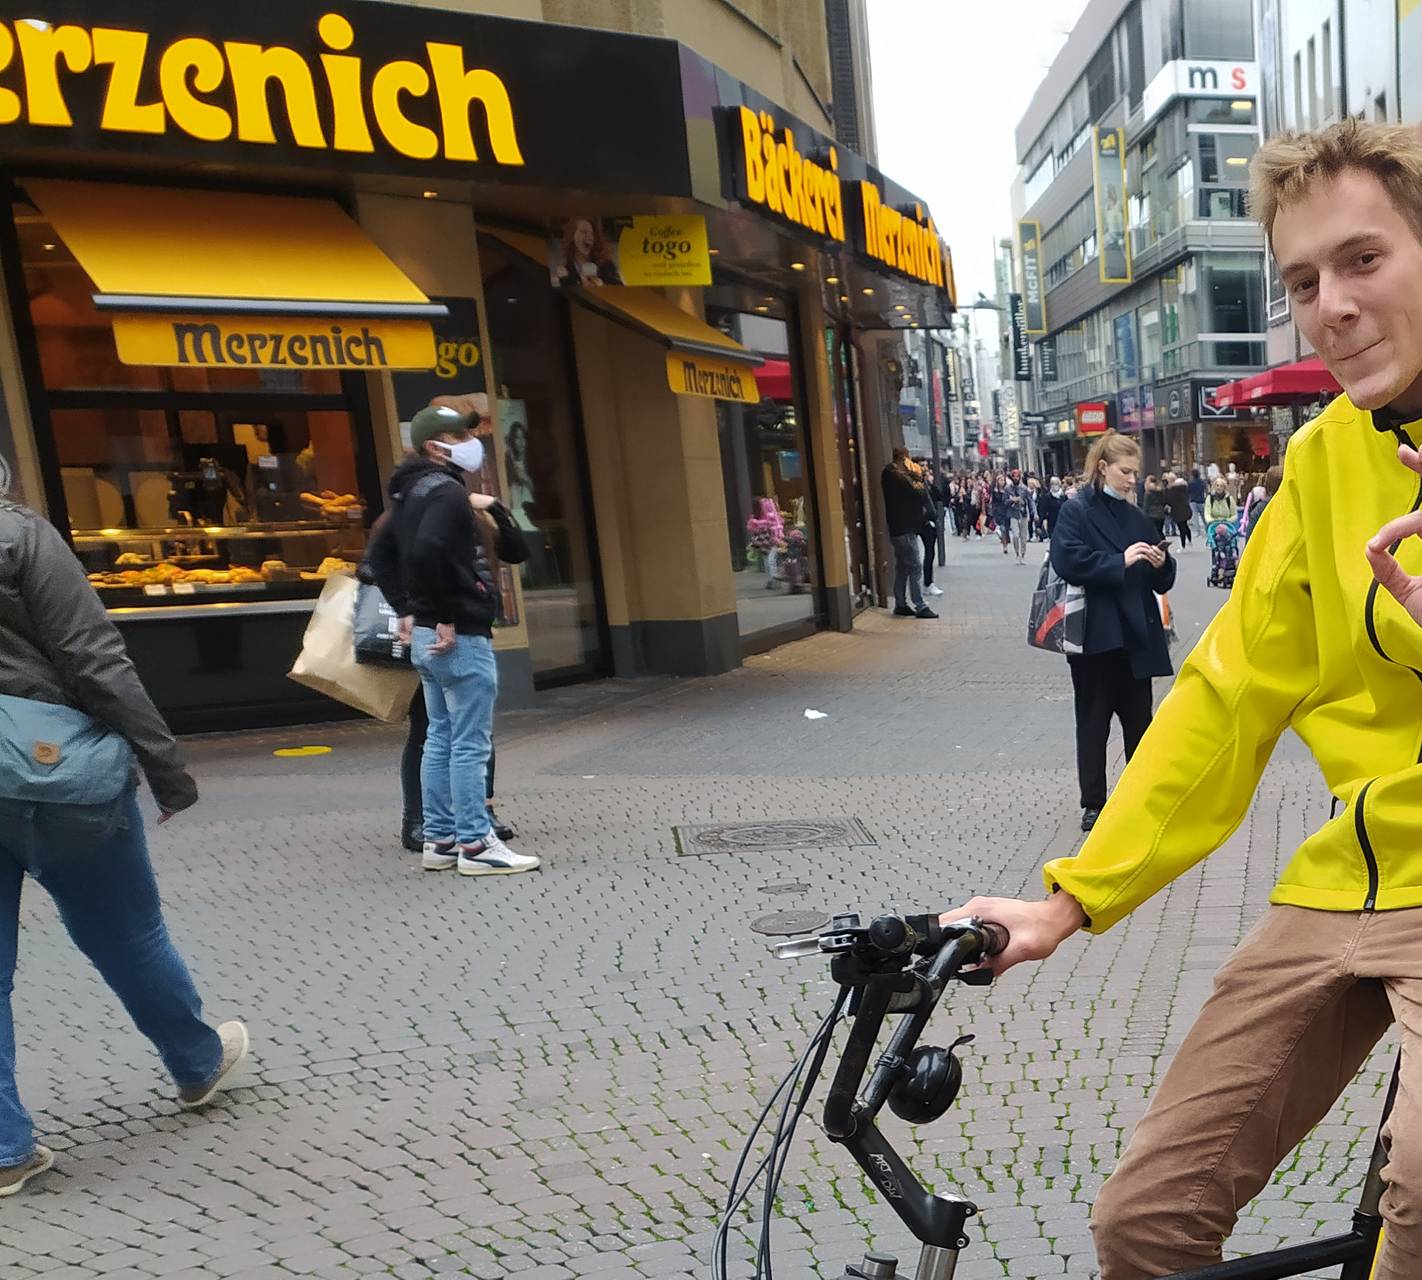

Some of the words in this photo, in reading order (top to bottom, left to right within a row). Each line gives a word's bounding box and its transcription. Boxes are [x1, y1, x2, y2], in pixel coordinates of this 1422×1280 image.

[740, 104, 845, 242] Bäckerei
[860, 179, 944, 288] Merzenich
[642, 237, 691, 260] togo
[650, 226, 683, 239] Coffee
[173, 322, 388, 367] Merzenich
[682, 360, 744, 400] Merzenich
